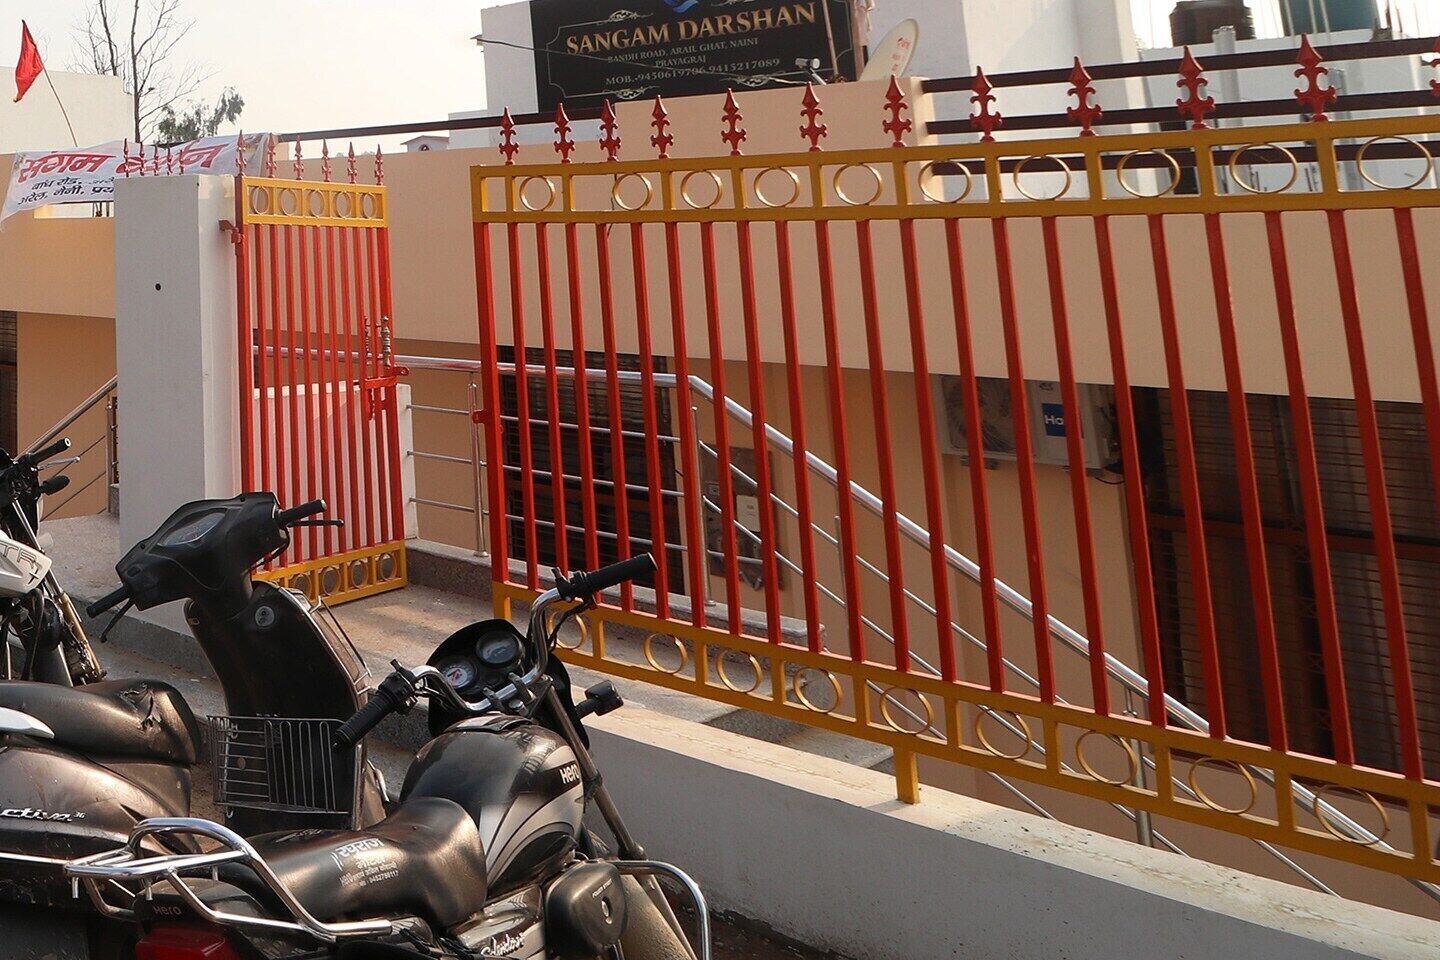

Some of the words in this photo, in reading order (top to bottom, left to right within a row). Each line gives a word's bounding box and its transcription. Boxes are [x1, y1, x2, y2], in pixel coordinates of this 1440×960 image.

[566, 22, 672, 55] SANGAM
[677, 2, 816, 40] DARSHAN
[671, 44, 698, 55] ARAIL
[729, 37, 759, 49] NAINI
[655, 54, 707, 67] PRAYAGRAJ
[708, 58, 781, 74] 9415217089
[153, 905, 182, 916] Hero
